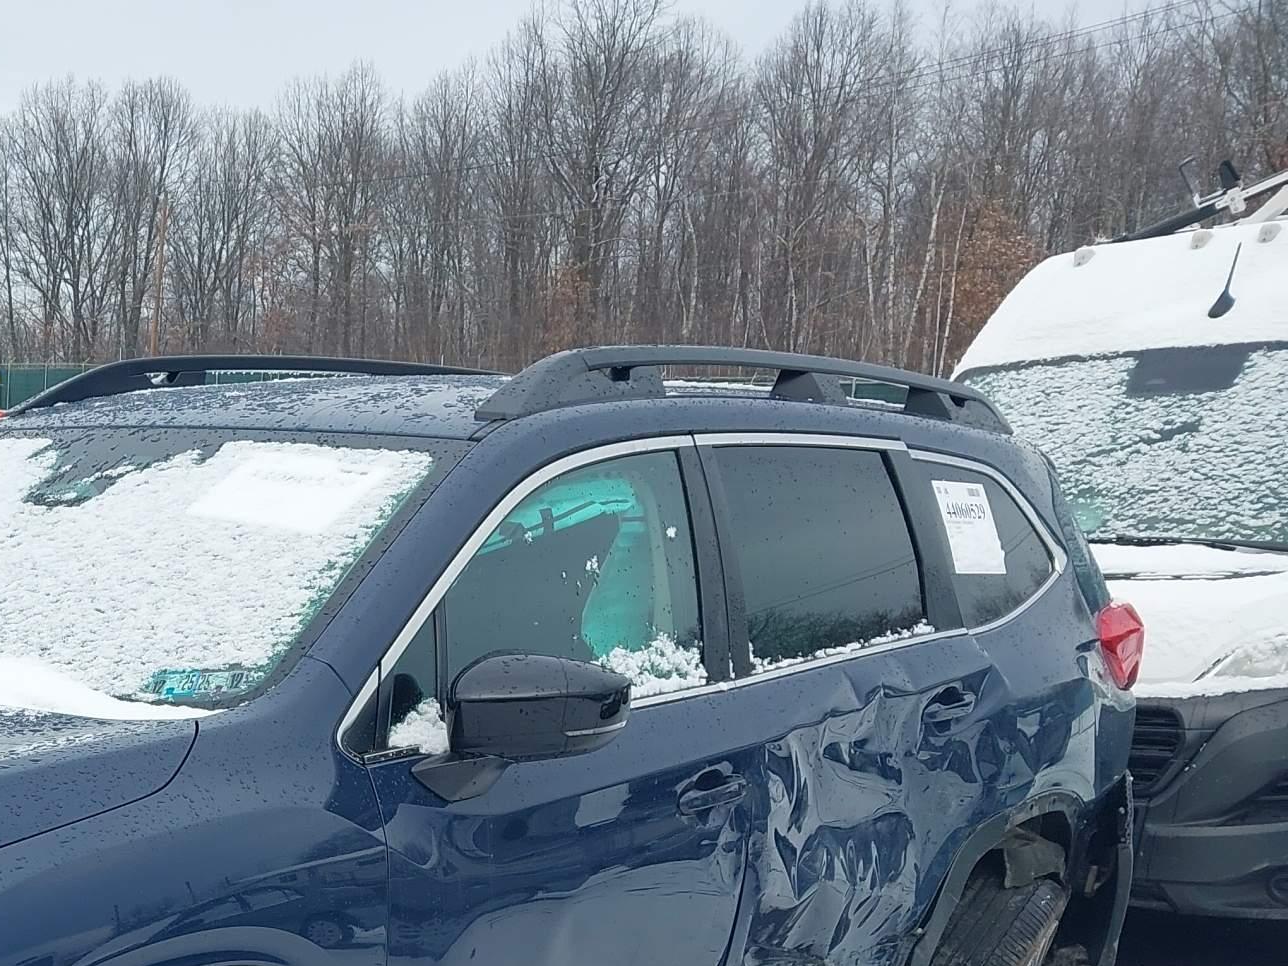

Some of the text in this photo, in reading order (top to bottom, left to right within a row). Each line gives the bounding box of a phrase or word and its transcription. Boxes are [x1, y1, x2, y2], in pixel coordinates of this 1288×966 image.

[945, 501, 985, 519] 44060529
[181, 673, 196, 691] 25
[198, 674, 213, 691] 25
